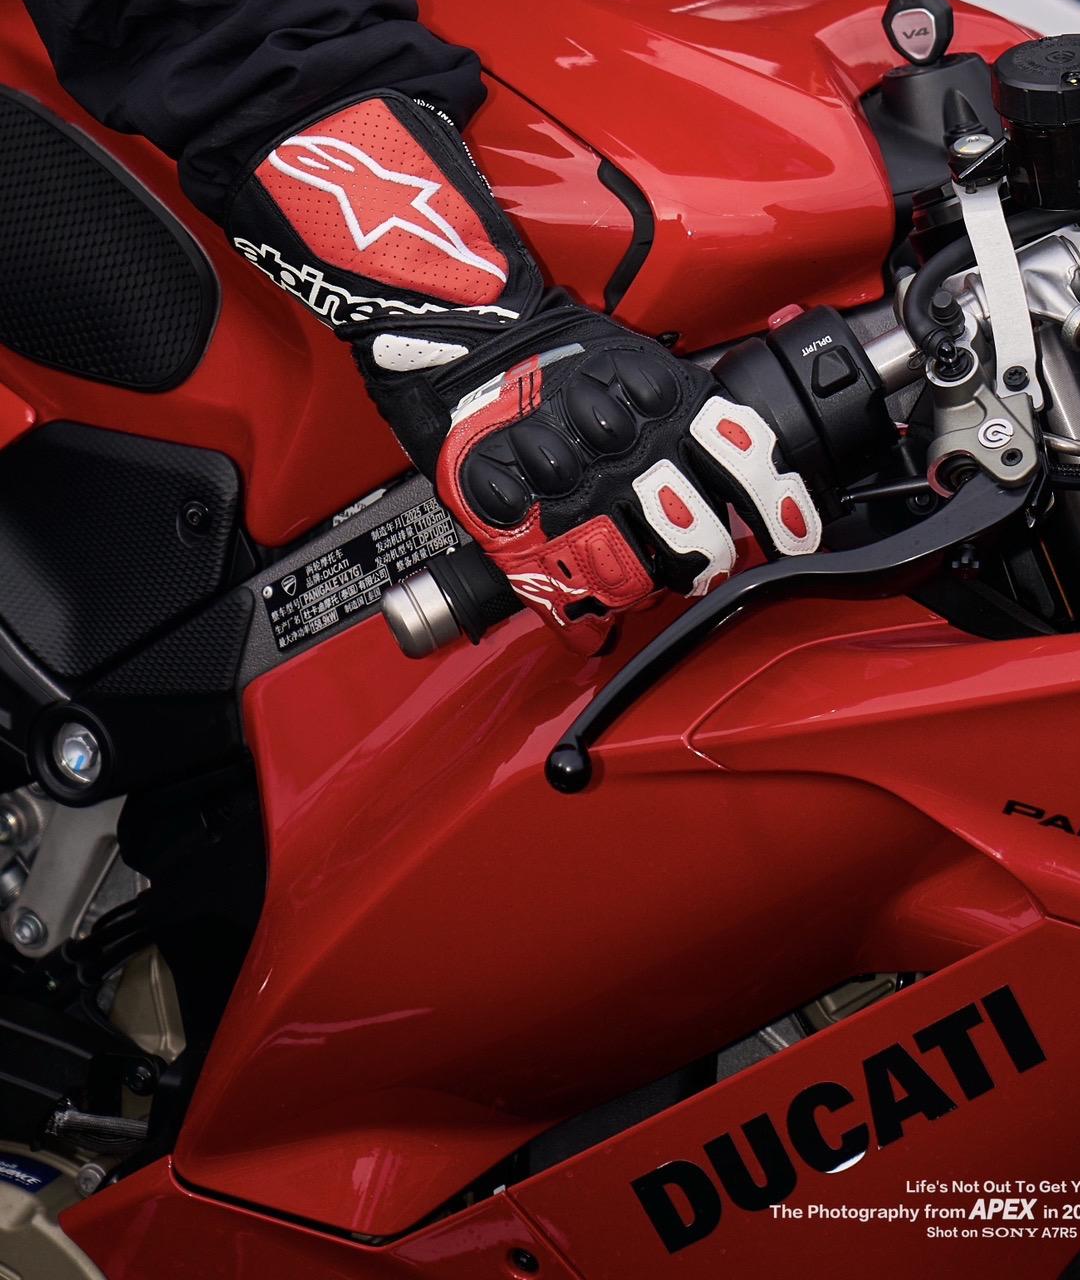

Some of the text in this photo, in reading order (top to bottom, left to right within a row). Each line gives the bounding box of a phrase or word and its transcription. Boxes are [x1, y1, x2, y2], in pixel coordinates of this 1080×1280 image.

[902, 26, 930, 40] V4
[404, 507, 422, 523] 2025
[418, 510, 446, 531] 1103ml
[429, 534, 455, 552] 199kg
[303, 577, 340, 604] PANIGALE
[629, 985, 1048, 1256] DUCATI
